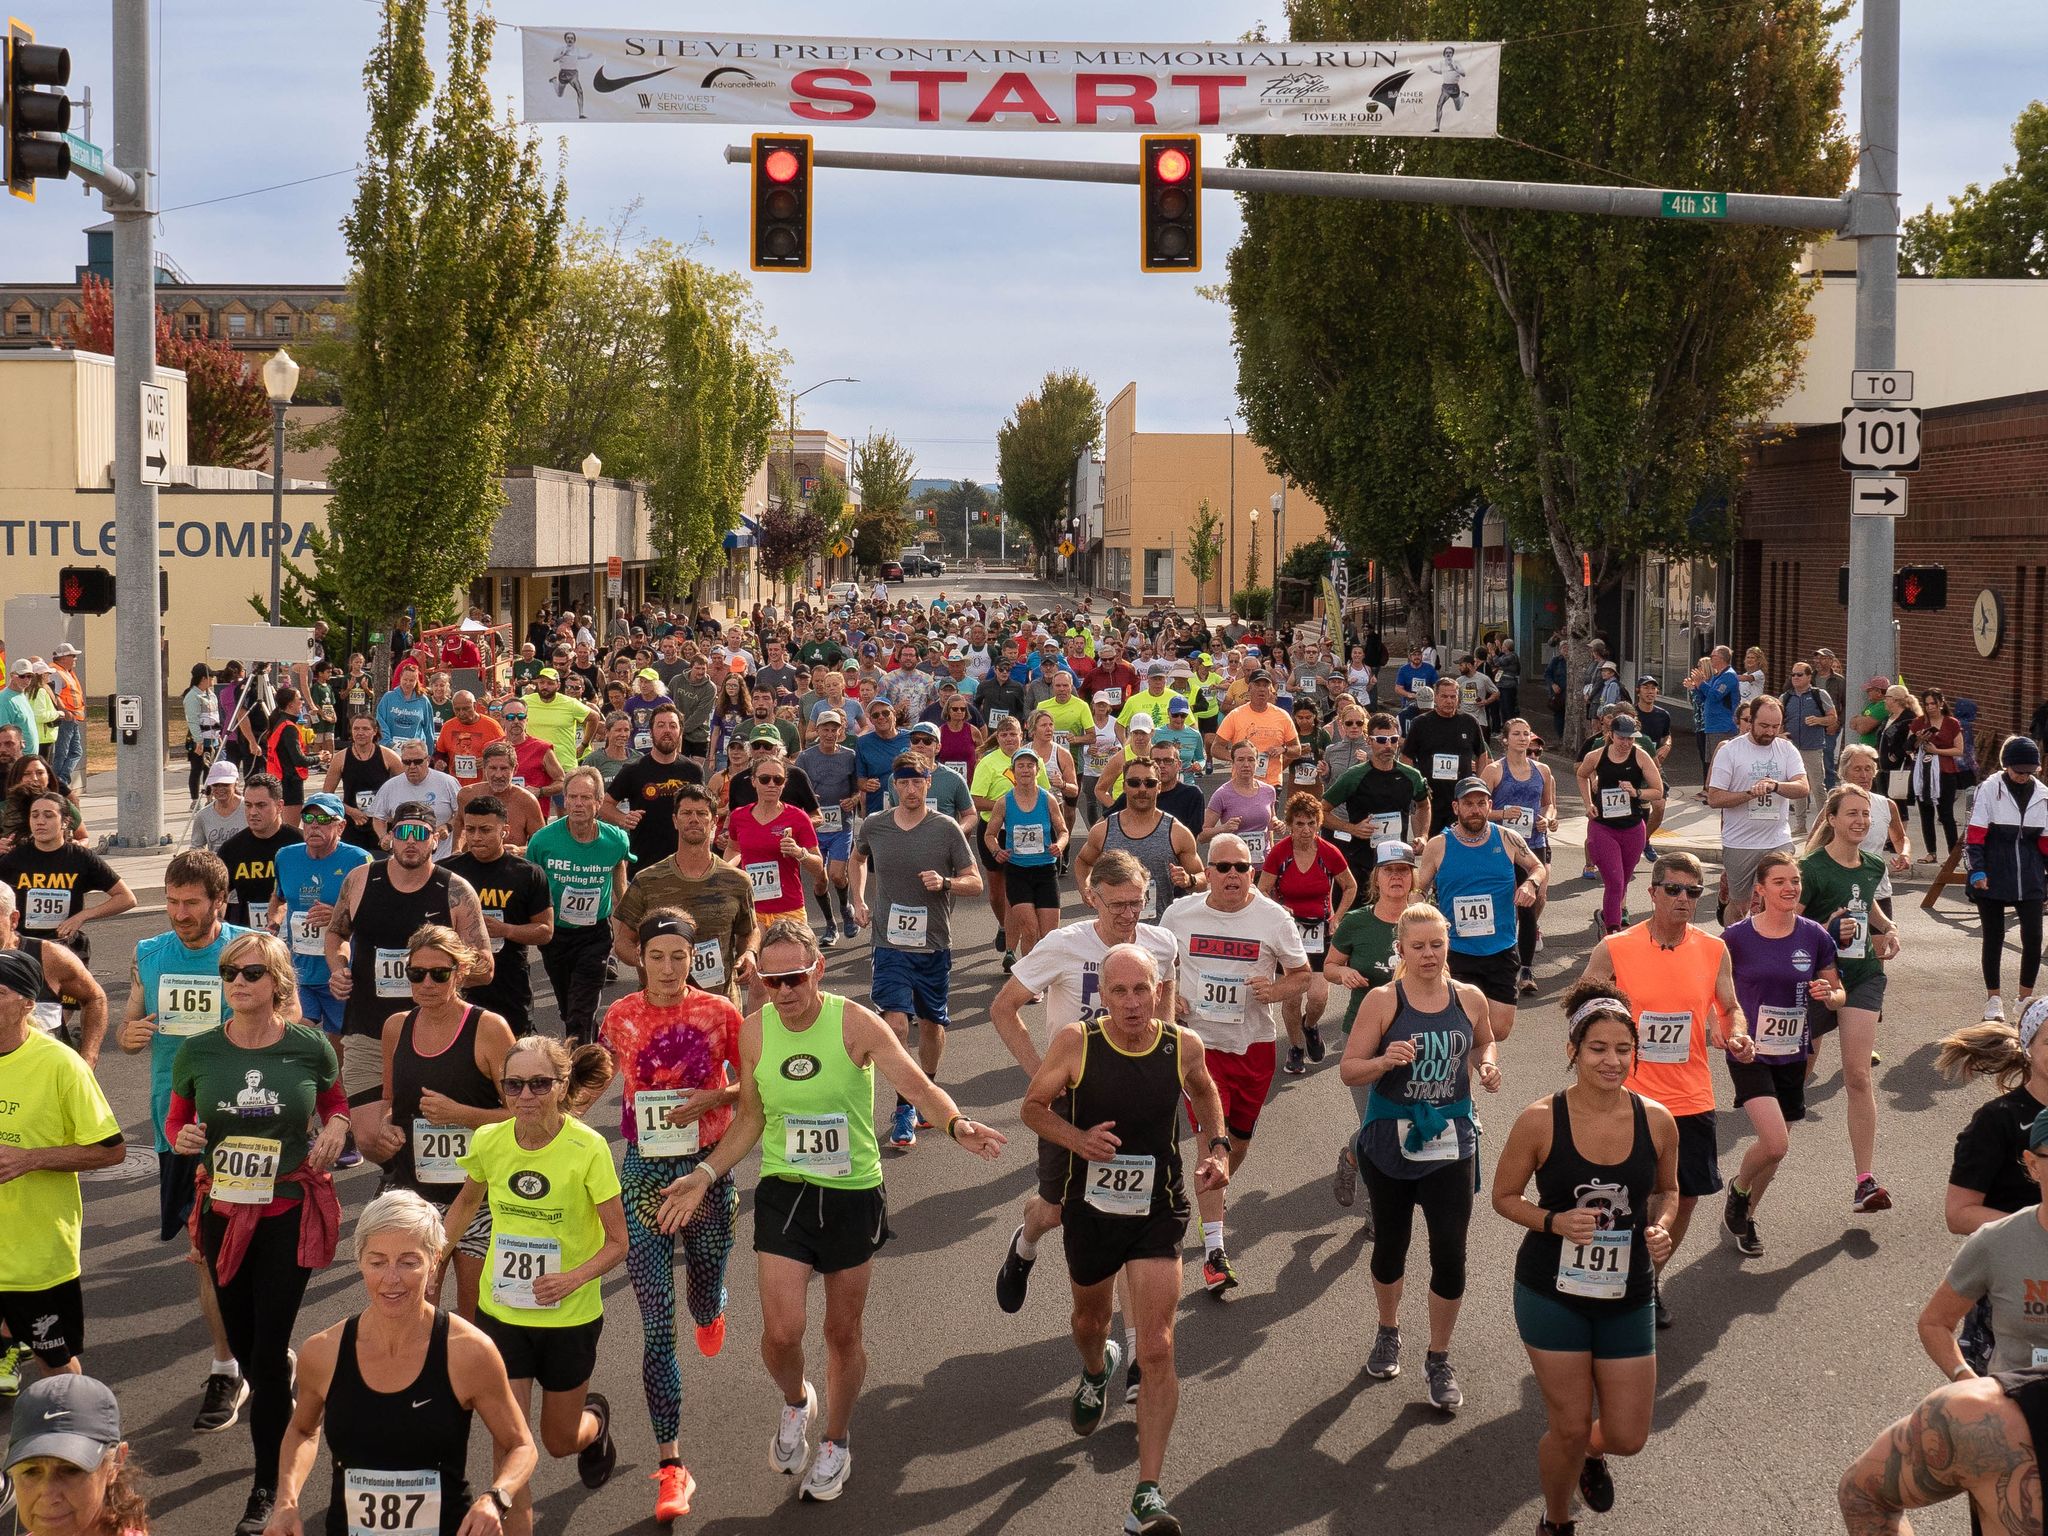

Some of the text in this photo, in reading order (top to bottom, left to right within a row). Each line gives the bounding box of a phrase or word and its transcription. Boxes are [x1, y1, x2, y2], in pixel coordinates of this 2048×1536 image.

[625, 37, 1399, 69] STEVE PREFONTAINE MEMORIAL RUN
[712, 80, 776, 89] AdvancedHealth
[1260, 77, 1331, 99] Pacific
[657, 92, 717, 103] VEND WEST
[789, 68, 1247, 125] START
[657, 102, 708, 111] SERVICES
[1302, 112, 1382, 122] TOWER FORD
[1671, 196, 1718, 214] 4th St
[1867, 377, 1896, 394] TO
[147, 394, 164, 416] ONE
[147, 419, 165, 441] WAY
[1857, 421, 1906, 454] 101
[0, 520, 116, 556] TITLE
[677, 687, 699, 699] RVCA
[457, 761, 473, 770] 173
[1298, 766, 1314, 777] 397
[1440, 760, 1451, 769] 10
[1606, 793, 1626, 806] 174
[1382, 821, 1389, 834] 7
[1022, 831, 1036, 843] 78
[547, 859, 571, 871] PRE
[573, 863, 582, 872] is
[582, 864, 602, 872] with
[17, 873, 78, 889] ARMY
[553, 873, 588, 885] Fighting
[33, 898, 64, 914] 395
[479, 888, 513, 908] MY
[566, 895, 595, 912] 207
[1460, 904, 1487, 921] 149
[898, 915, 918, 931] 52
[692, 951, 716, 973] 86
[169, 989, 211, 1012] 165
[1204, 982, 1237, 1004] 301
[1647, 1025, 1684, 1044] 127
[1764, 1018, 1797, 1037] 290
[1411, 1031, 1467, 1061] FIND
[1410, 1058, 1459, 1081] YOUR
[1404, 1080, 1455, 1100] STRONG
[241, 1107, 274, 1119] PRE
[422, 1134, 467, 1158] 203
[796, 1129, 839, 1153] 130
[215, 1149, 273, 1179] 2061
[1097, 1168, 1145, 1192] 282
[499, 1203, 537, 1218] Training
[507, 1239, 528, 1248] Prefontaine
[503, 1251, 545, 1280] 281
[1572, 1244, 1619, 1272] 191
[350, 1475, 437, 1487] 41st Prefontaine Memorial Run
[358, 1493, 426, 1530] 387
